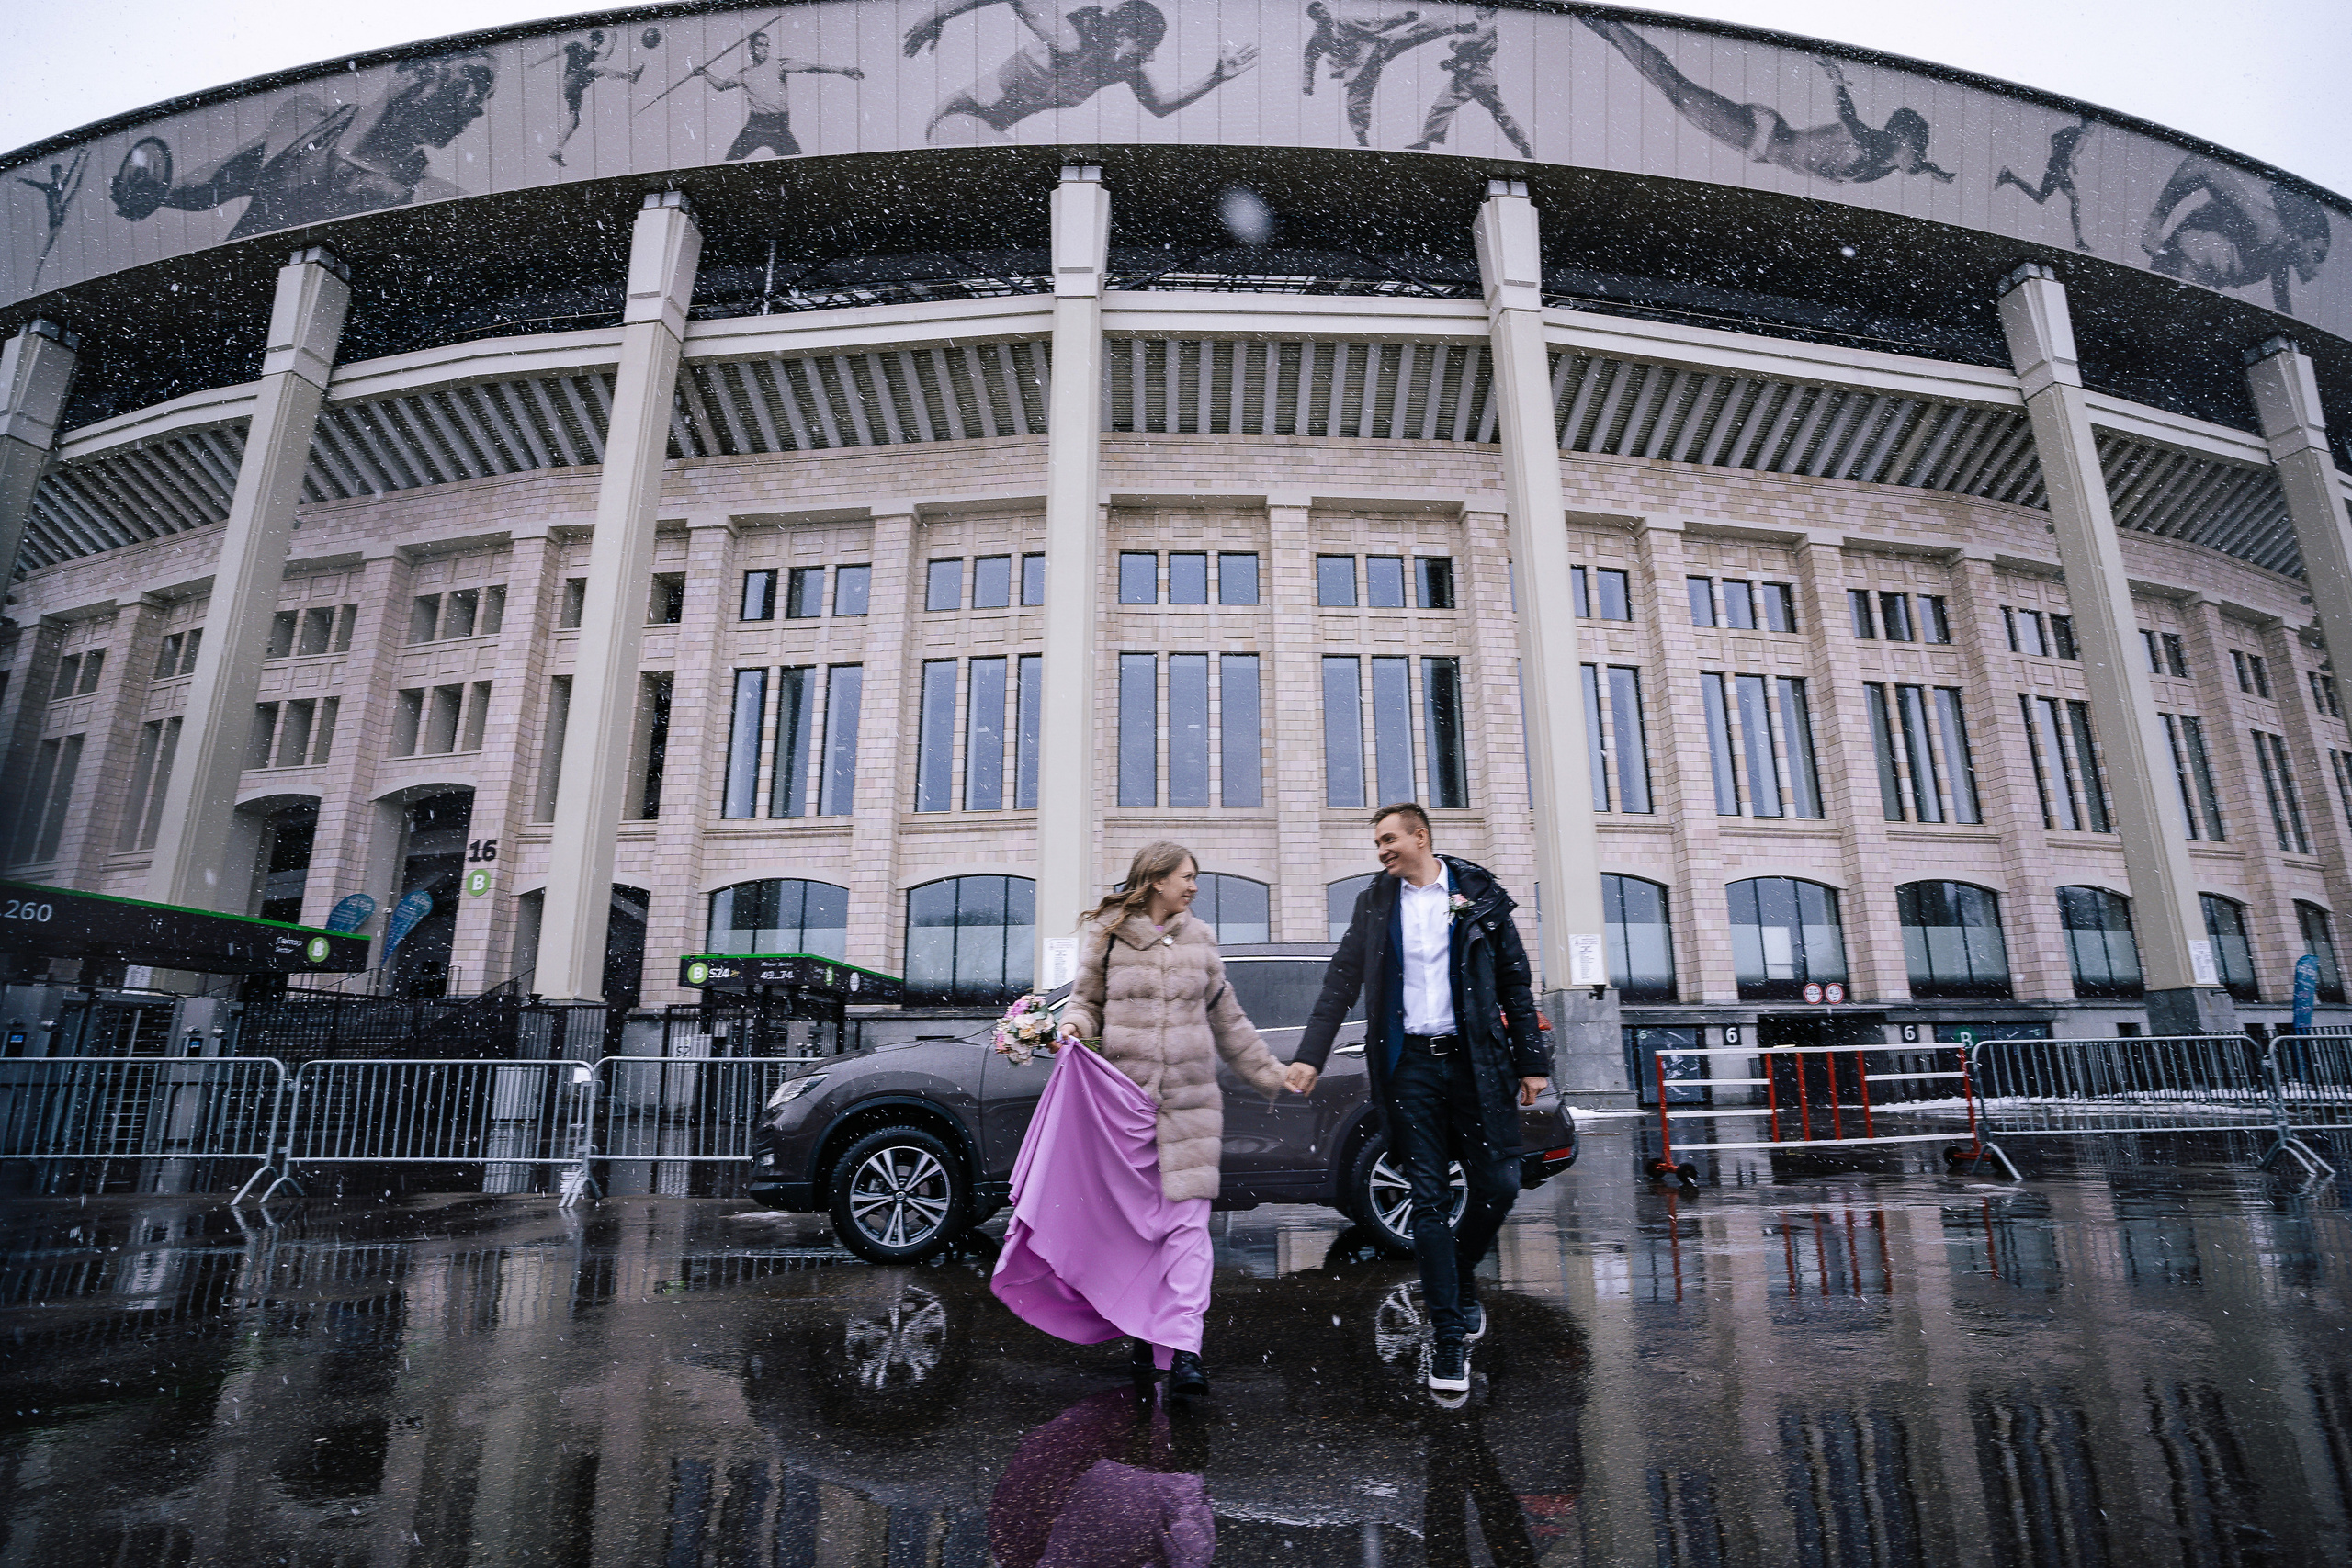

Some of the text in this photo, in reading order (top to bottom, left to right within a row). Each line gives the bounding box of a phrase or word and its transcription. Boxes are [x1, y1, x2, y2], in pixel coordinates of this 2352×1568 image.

[468, 839, 497, 862] 16
[471, 874, 486, 891] B
[693, 966, 704, 980] B
[1725, 1027, 1738, 1043] 6
[1904, 1025, 1917, 1041] 6
